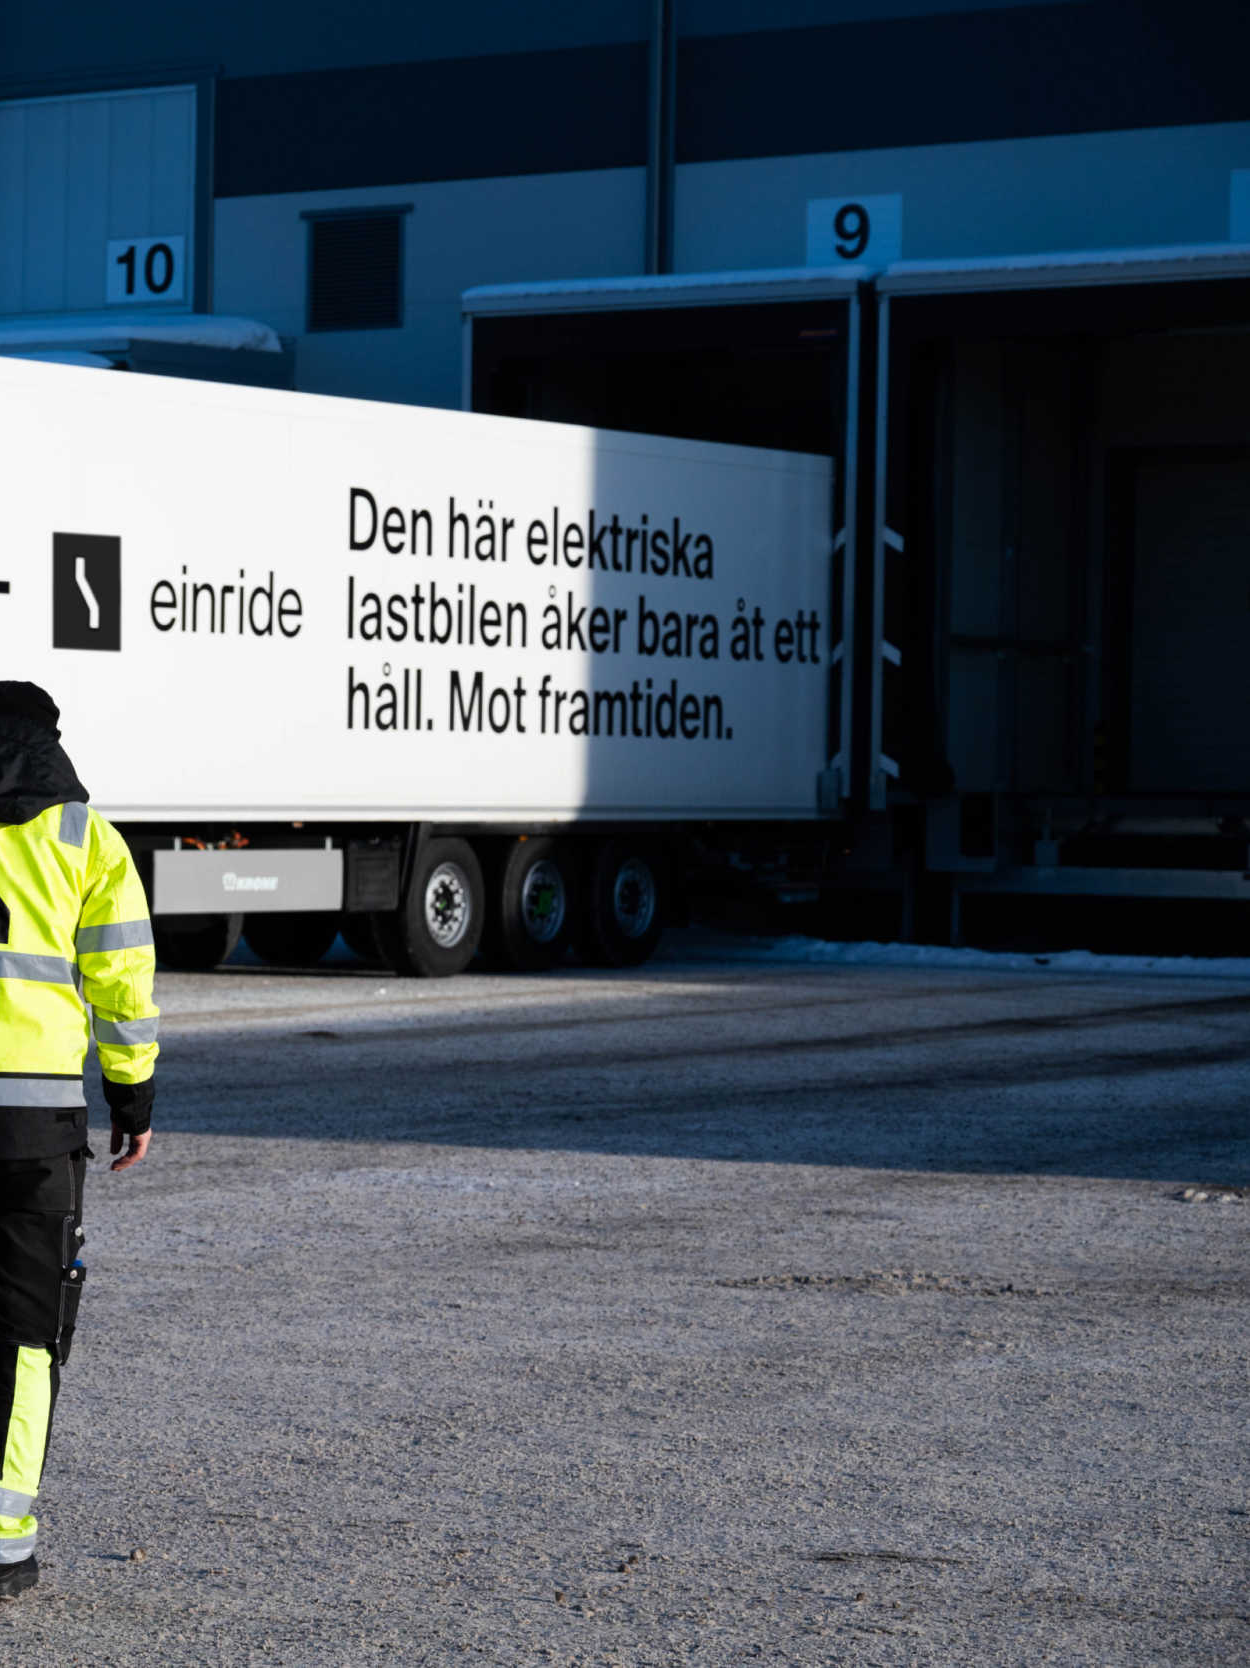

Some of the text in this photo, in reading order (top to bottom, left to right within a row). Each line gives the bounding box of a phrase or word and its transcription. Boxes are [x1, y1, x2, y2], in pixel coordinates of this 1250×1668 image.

[116, 242, 175, 295] 10
[833, 203, 871, 260] 9
[349, 487, 714, 579] Den här elektriska
[150, 565, 303, 638] einride
[347, 575, 820, 664] lastbilen åker bara åt ett
[347, 662, 733, 740] håll. Mot framtiden.
